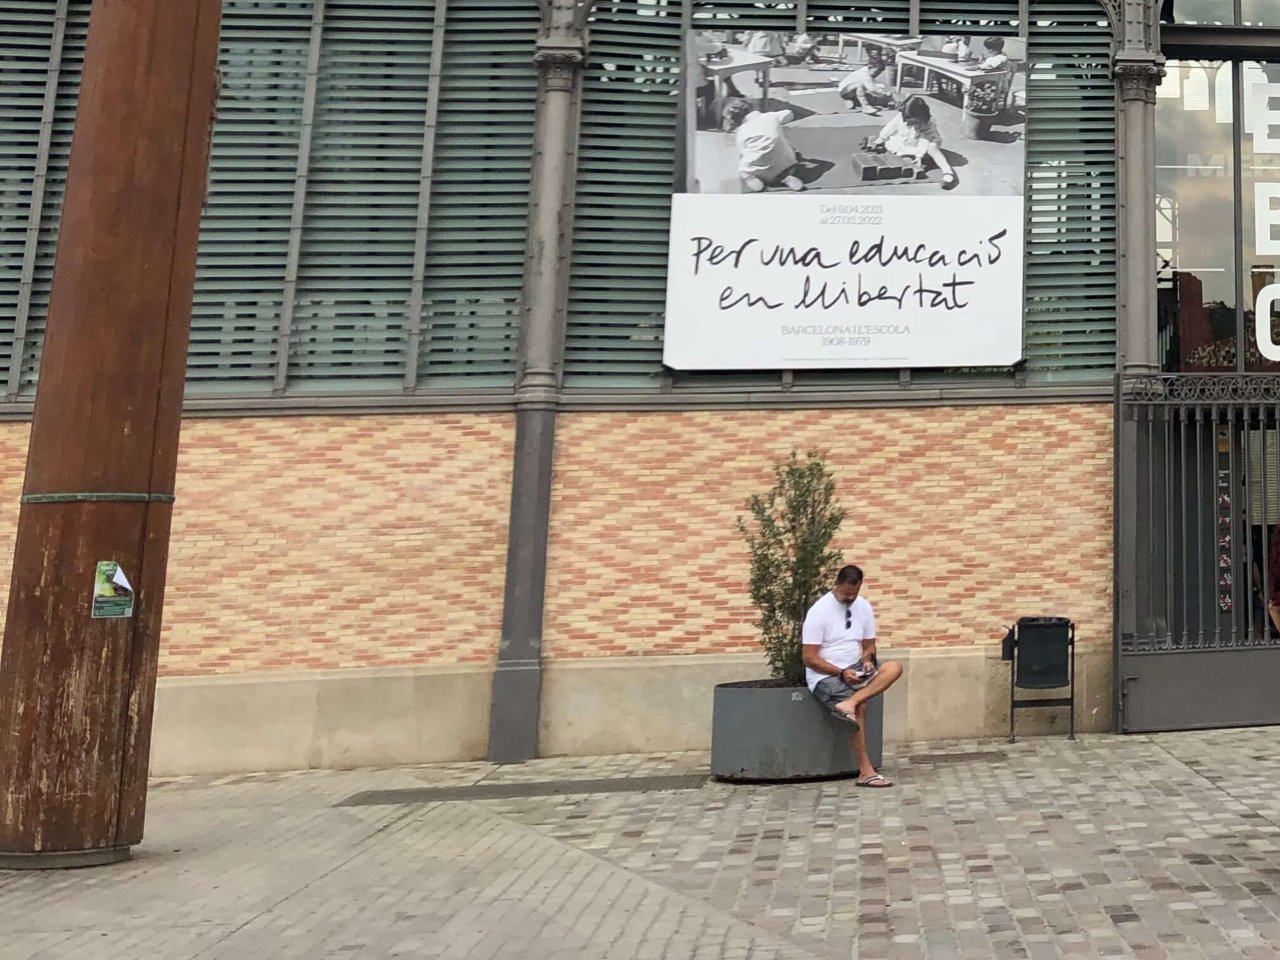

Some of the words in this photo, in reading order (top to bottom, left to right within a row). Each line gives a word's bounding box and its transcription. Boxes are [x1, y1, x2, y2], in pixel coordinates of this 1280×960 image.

[691, 236, 759, 275] Per
[760, 246, 842, 269] una
[849, 229, 1007, 270] educació
[719, 285, 785, 310] en
[794, 273, 976, 311] llibertat
[781, 325, 851, 335] BARCELONA
